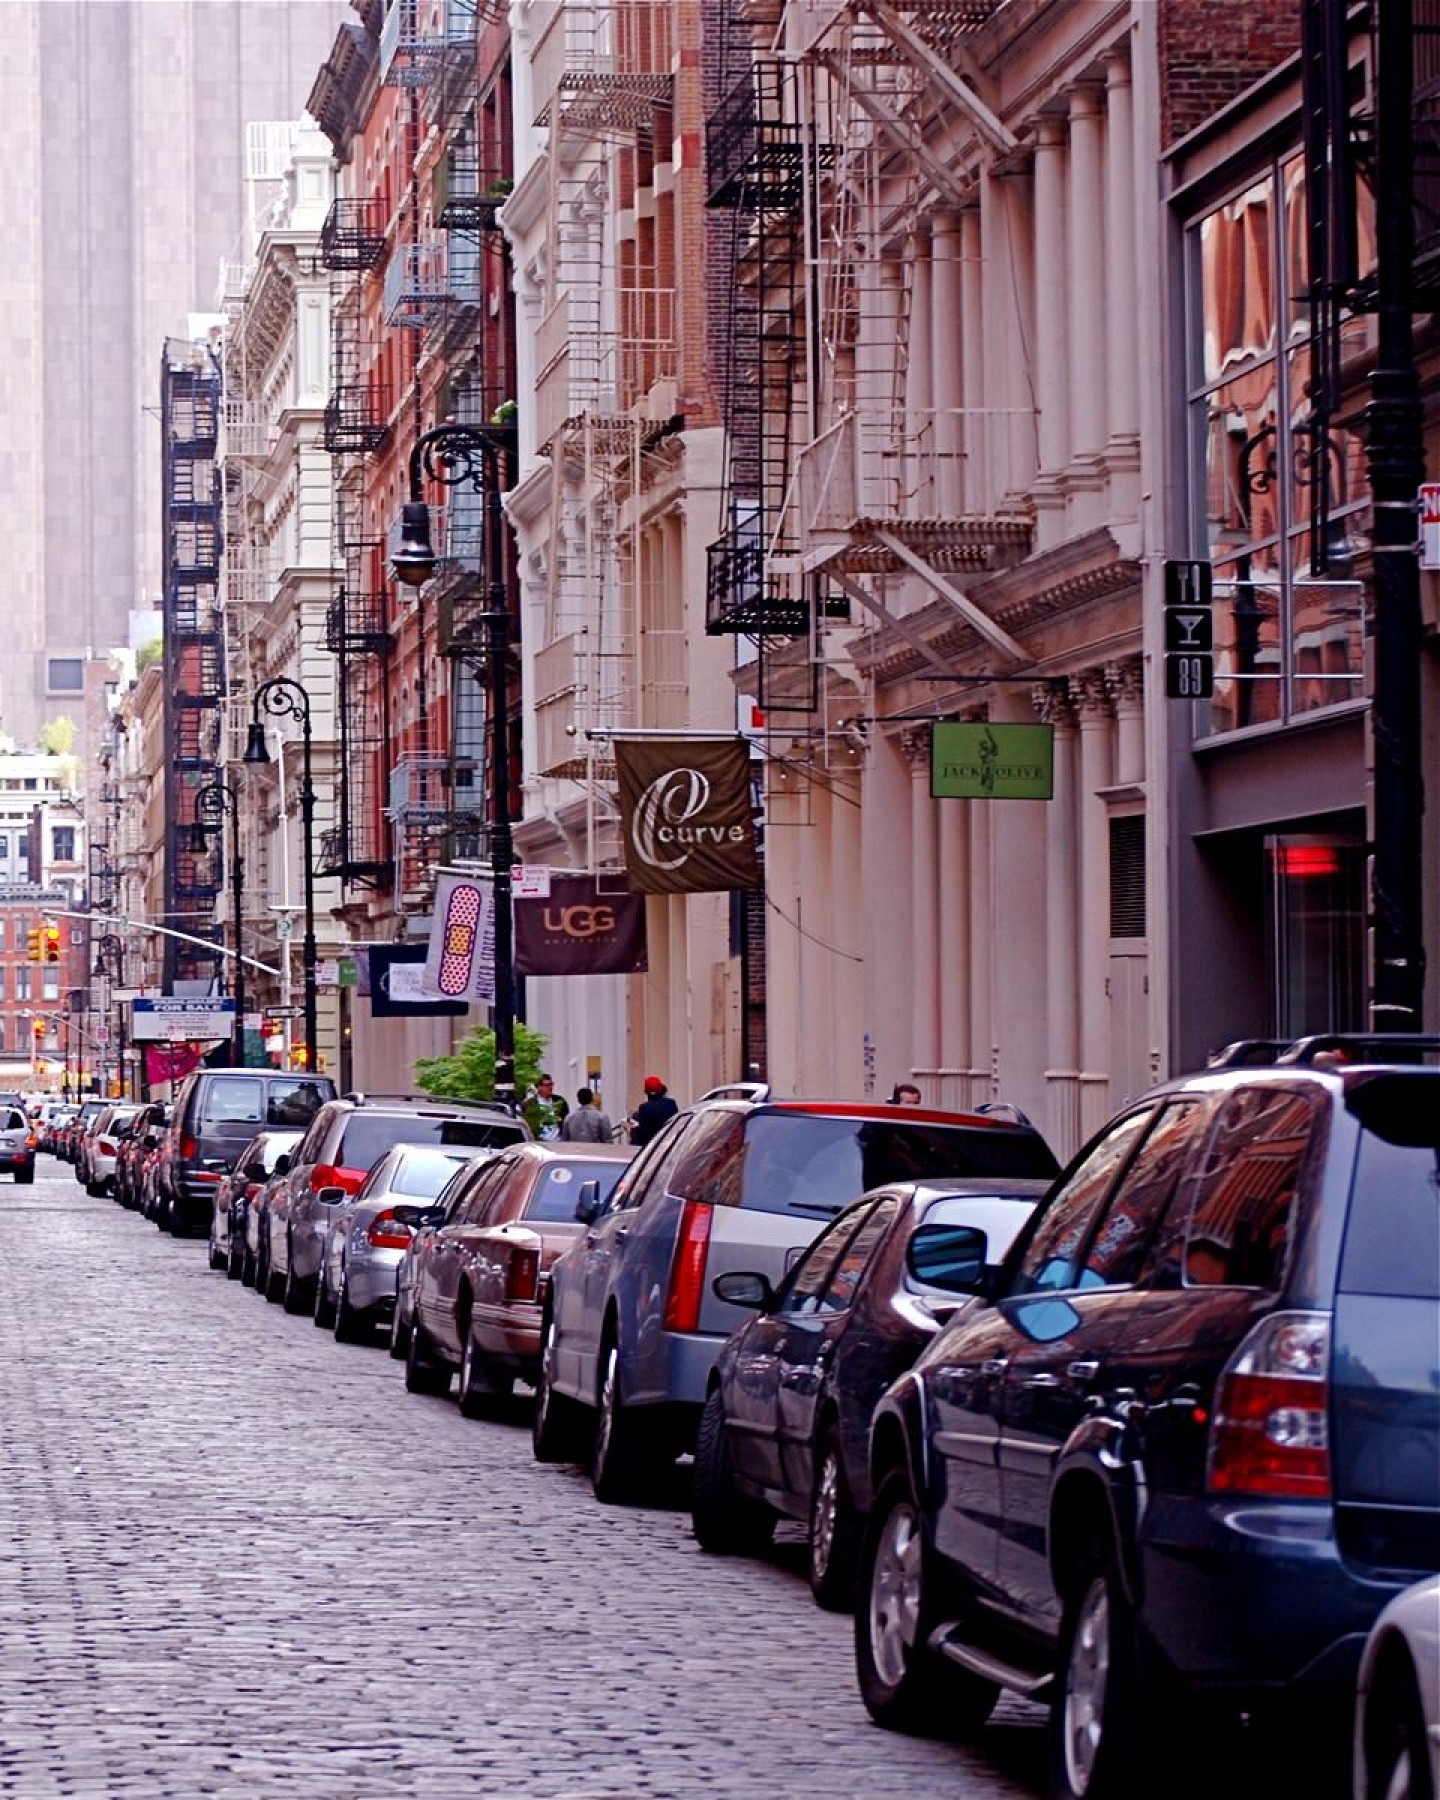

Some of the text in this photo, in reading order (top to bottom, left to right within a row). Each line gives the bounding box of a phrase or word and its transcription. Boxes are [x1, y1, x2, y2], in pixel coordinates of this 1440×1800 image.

[1423, 490, 1440, 518] N
[1179, 657, 1202, 696] 89
[657, 824, 745, 844] curve
[542, 905, 616, 937] UGG
[152, 1003, 221, 1012] FOR SALE
